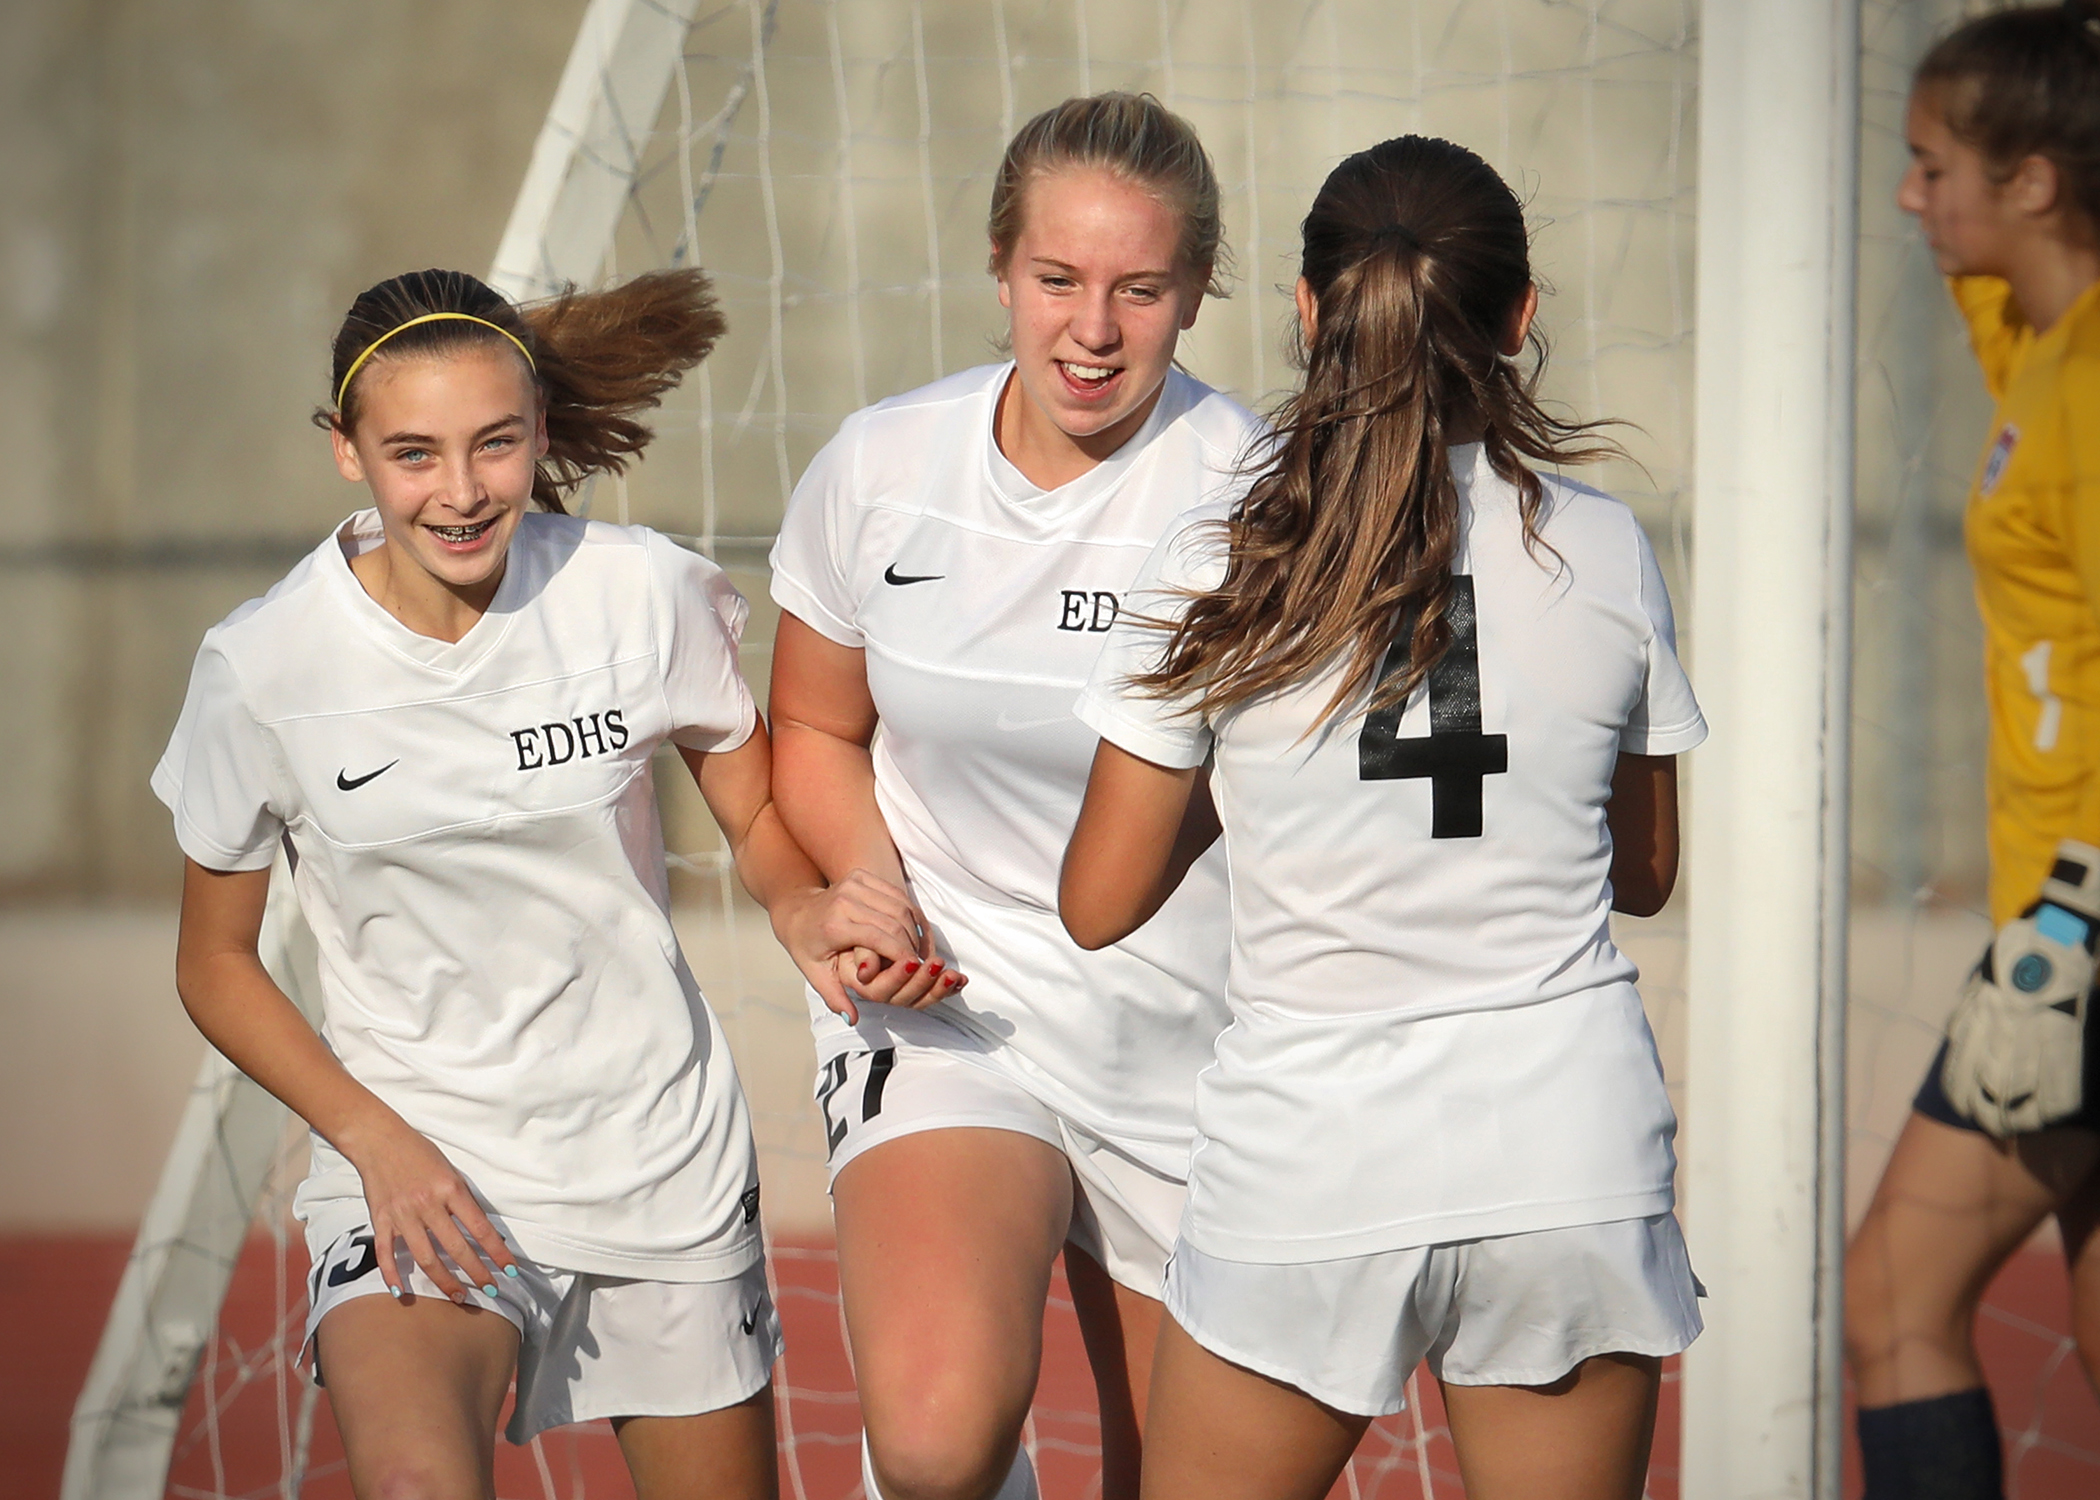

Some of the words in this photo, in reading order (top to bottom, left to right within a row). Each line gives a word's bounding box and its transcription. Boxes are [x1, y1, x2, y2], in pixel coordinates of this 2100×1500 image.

[1057, 590, 1127, 632] ED
[1359, 574, 1507, 838] 4
[510, 709, 629, 771] EDHS
